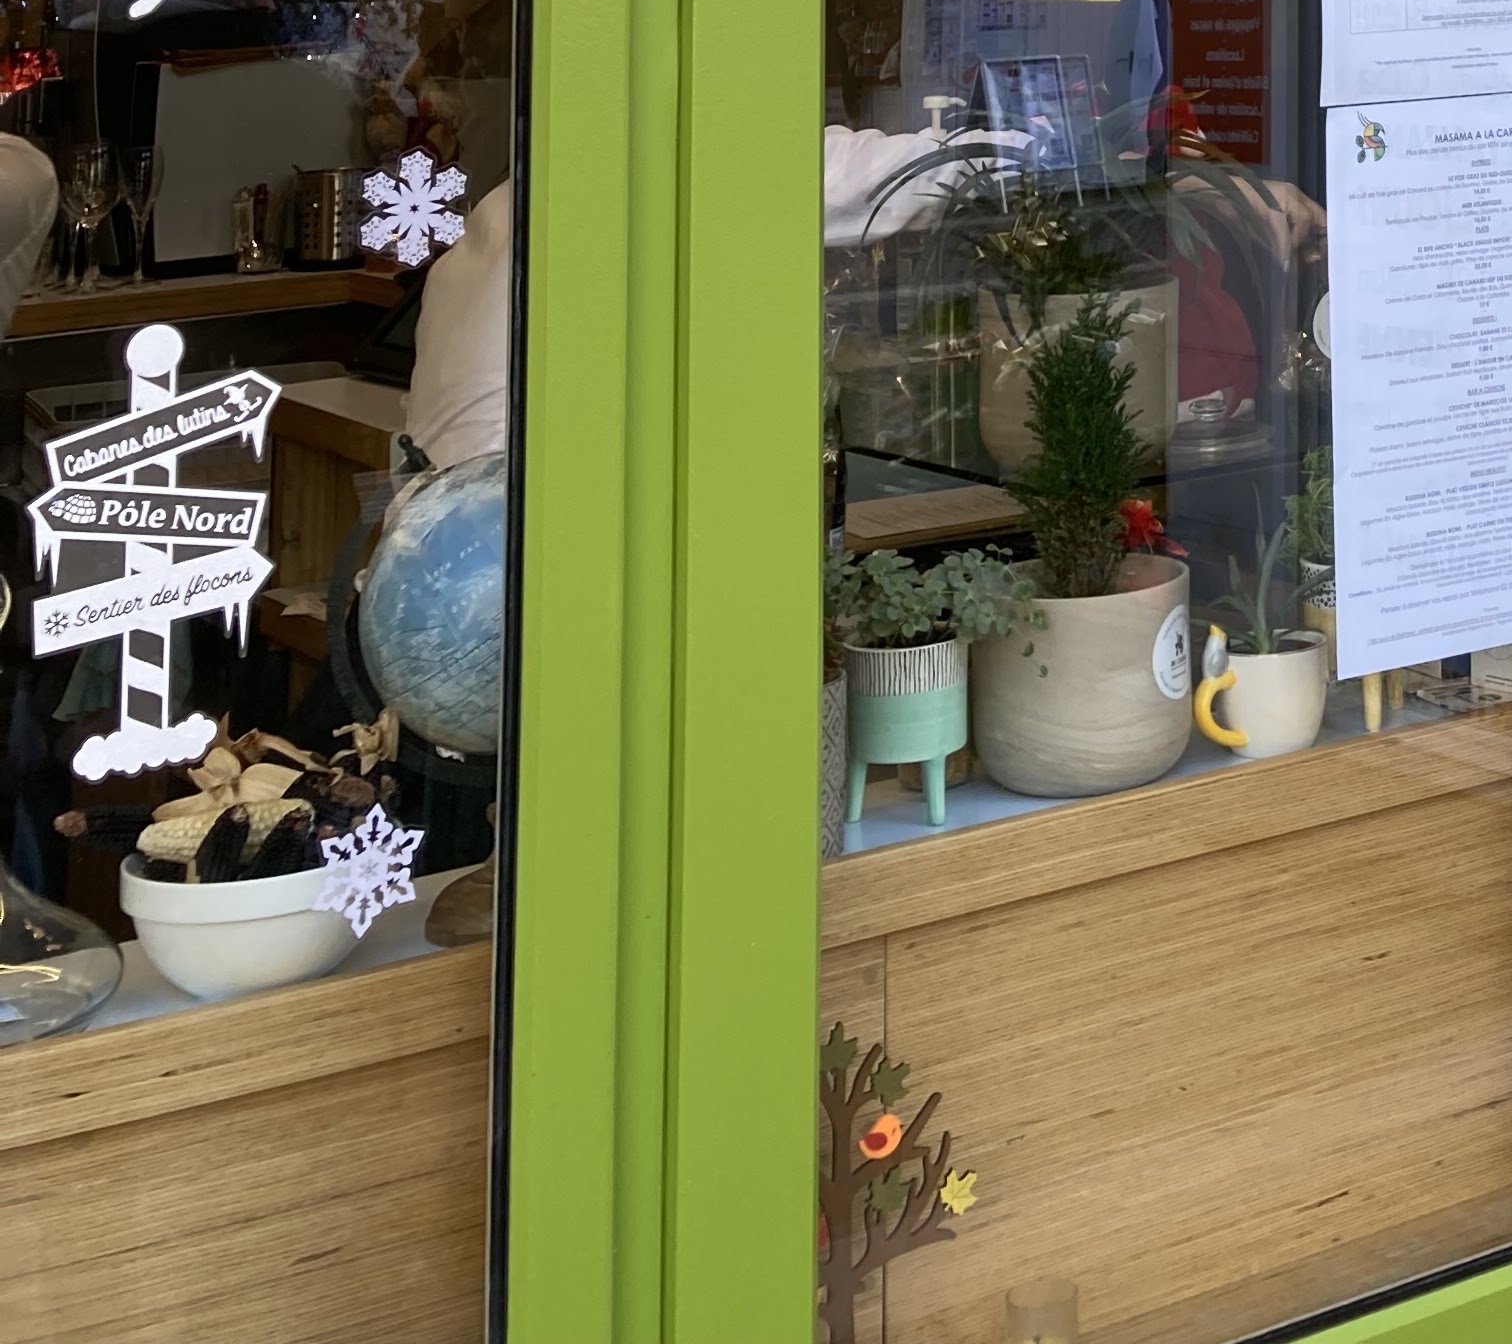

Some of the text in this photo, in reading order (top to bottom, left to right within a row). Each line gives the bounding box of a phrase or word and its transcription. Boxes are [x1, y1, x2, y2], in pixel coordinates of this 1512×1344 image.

[1434, 131, 1473, 144] MASAMA
[1484, 129, 1495, 139] LA
[63, 404, 231, 478] Cabanes des lutins
[98, 498, 255, 535] Pôle Nord
[74, 566, 255, 628] Sentier des flocons
